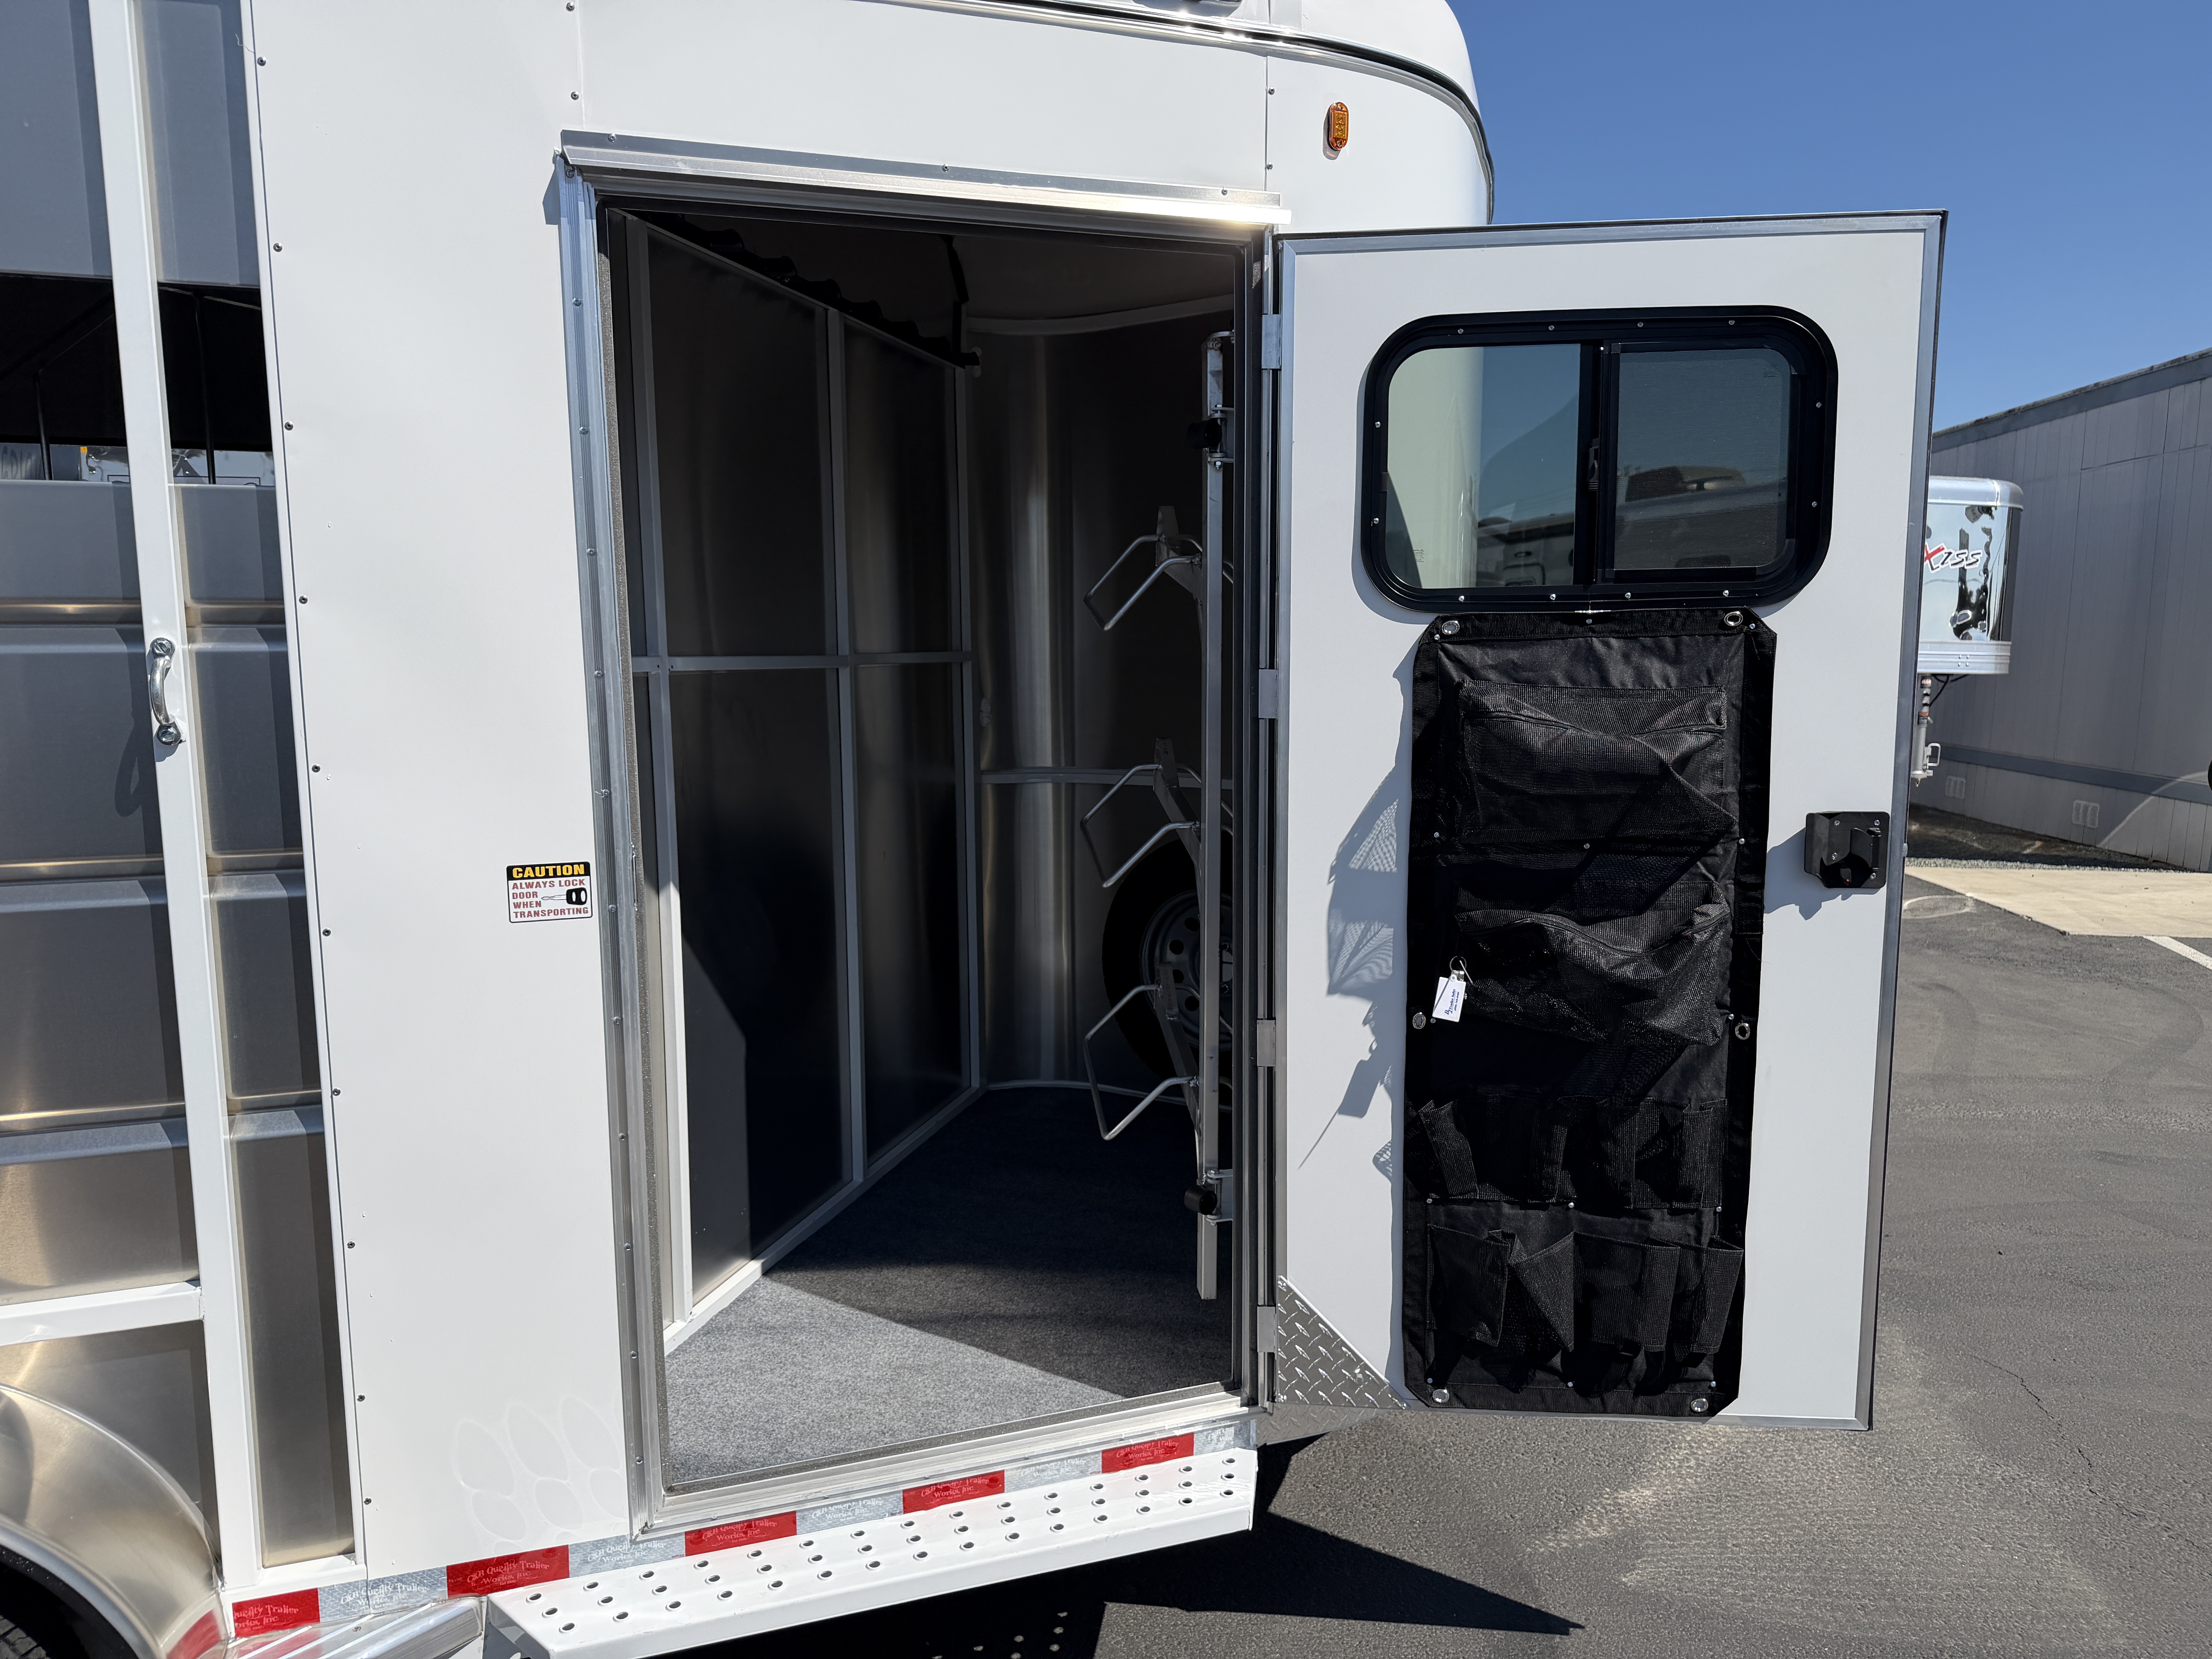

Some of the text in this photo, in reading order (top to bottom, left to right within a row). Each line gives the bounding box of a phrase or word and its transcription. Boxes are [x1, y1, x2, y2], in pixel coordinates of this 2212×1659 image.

[512, 864, 585, 878] CAUTION
[512, 879, 586, 890] ALWAYS LOCK
[513, 907, 589, 918] TRANSPORTING
[487, 1559, 518, 1575] Quality
[519, 1560, 549, 1571] Trailer
[265, 1604, 299, 1616] Trailer
